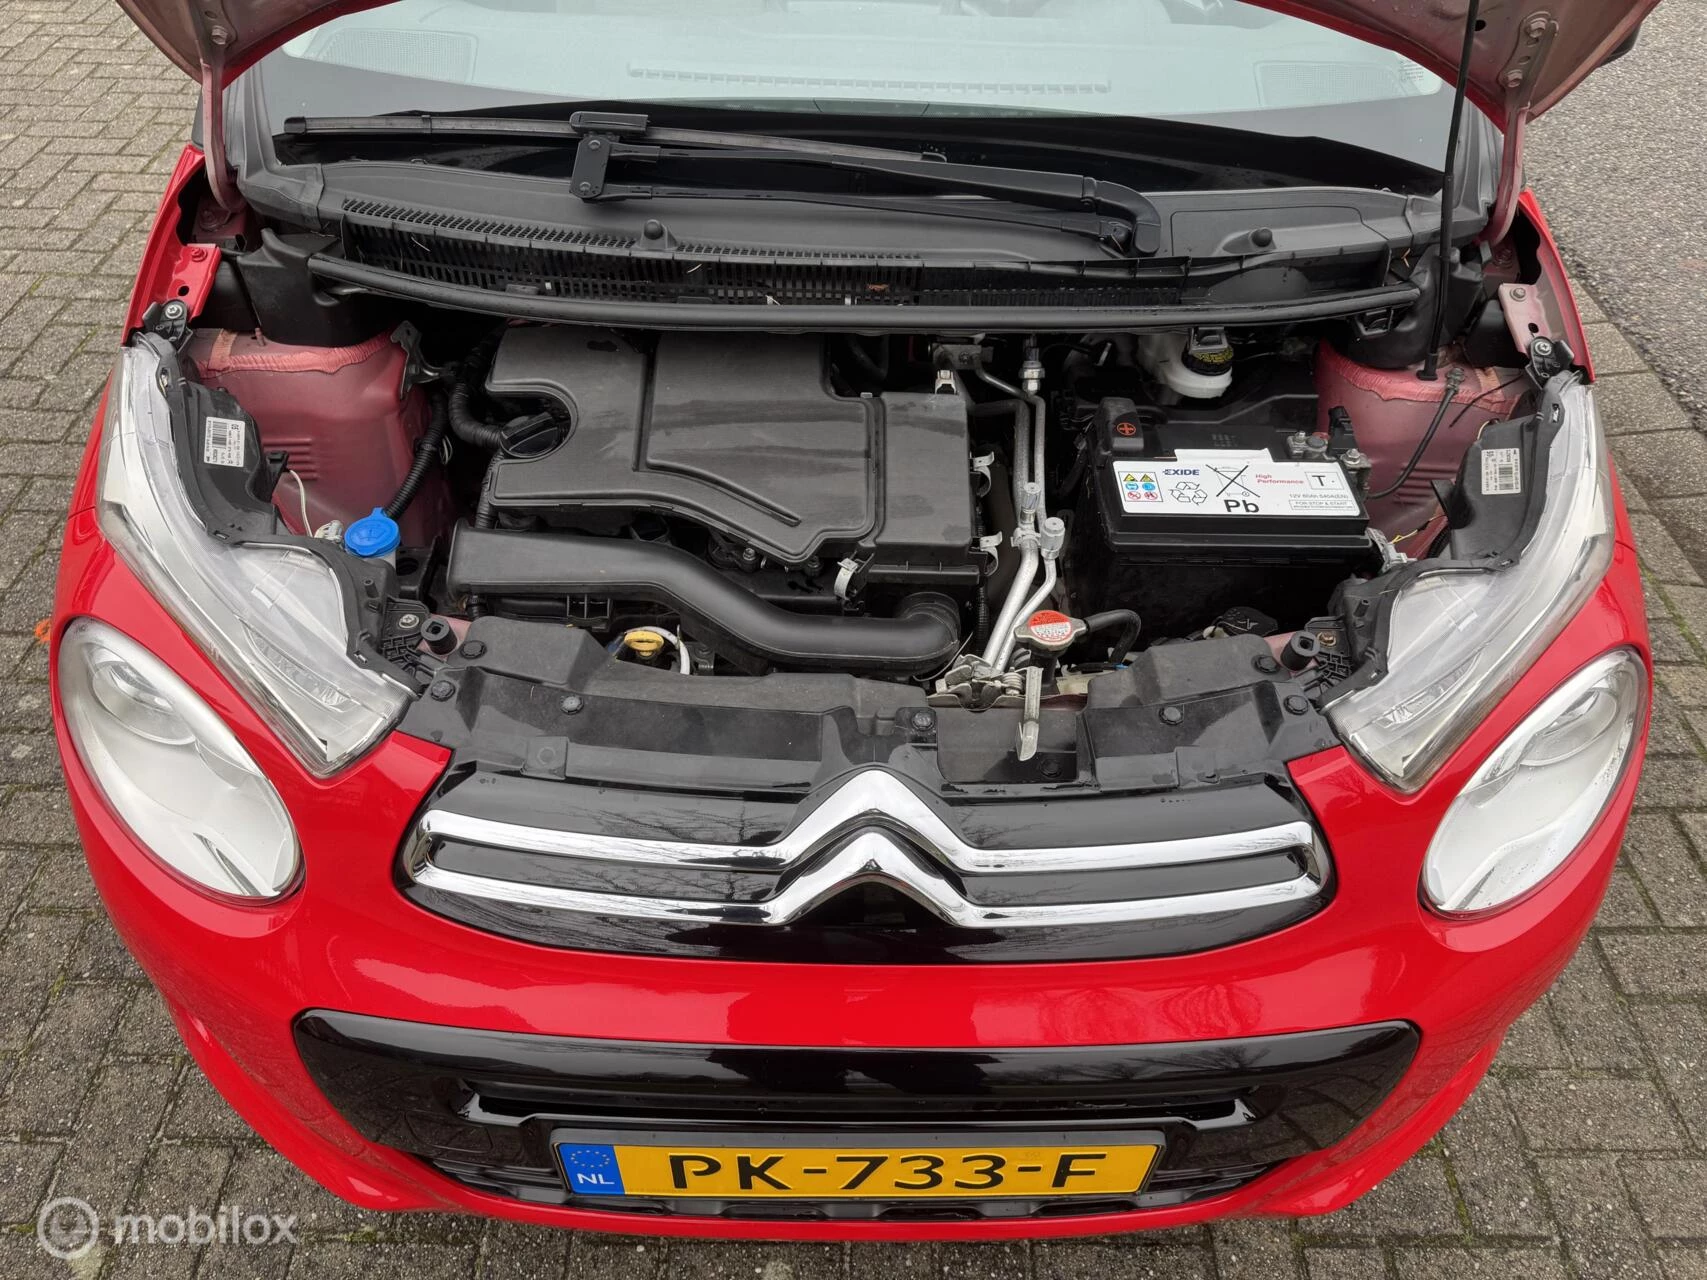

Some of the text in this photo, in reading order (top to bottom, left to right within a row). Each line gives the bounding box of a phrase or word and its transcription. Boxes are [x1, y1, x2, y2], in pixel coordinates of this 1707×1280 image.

[1311, 475, 1326, 487] T
[1224, 499, 1260, 513] Pb
[669, 1153, 1107, 1190] PK-733-F
[577, 1173, 615, 1185] NL
